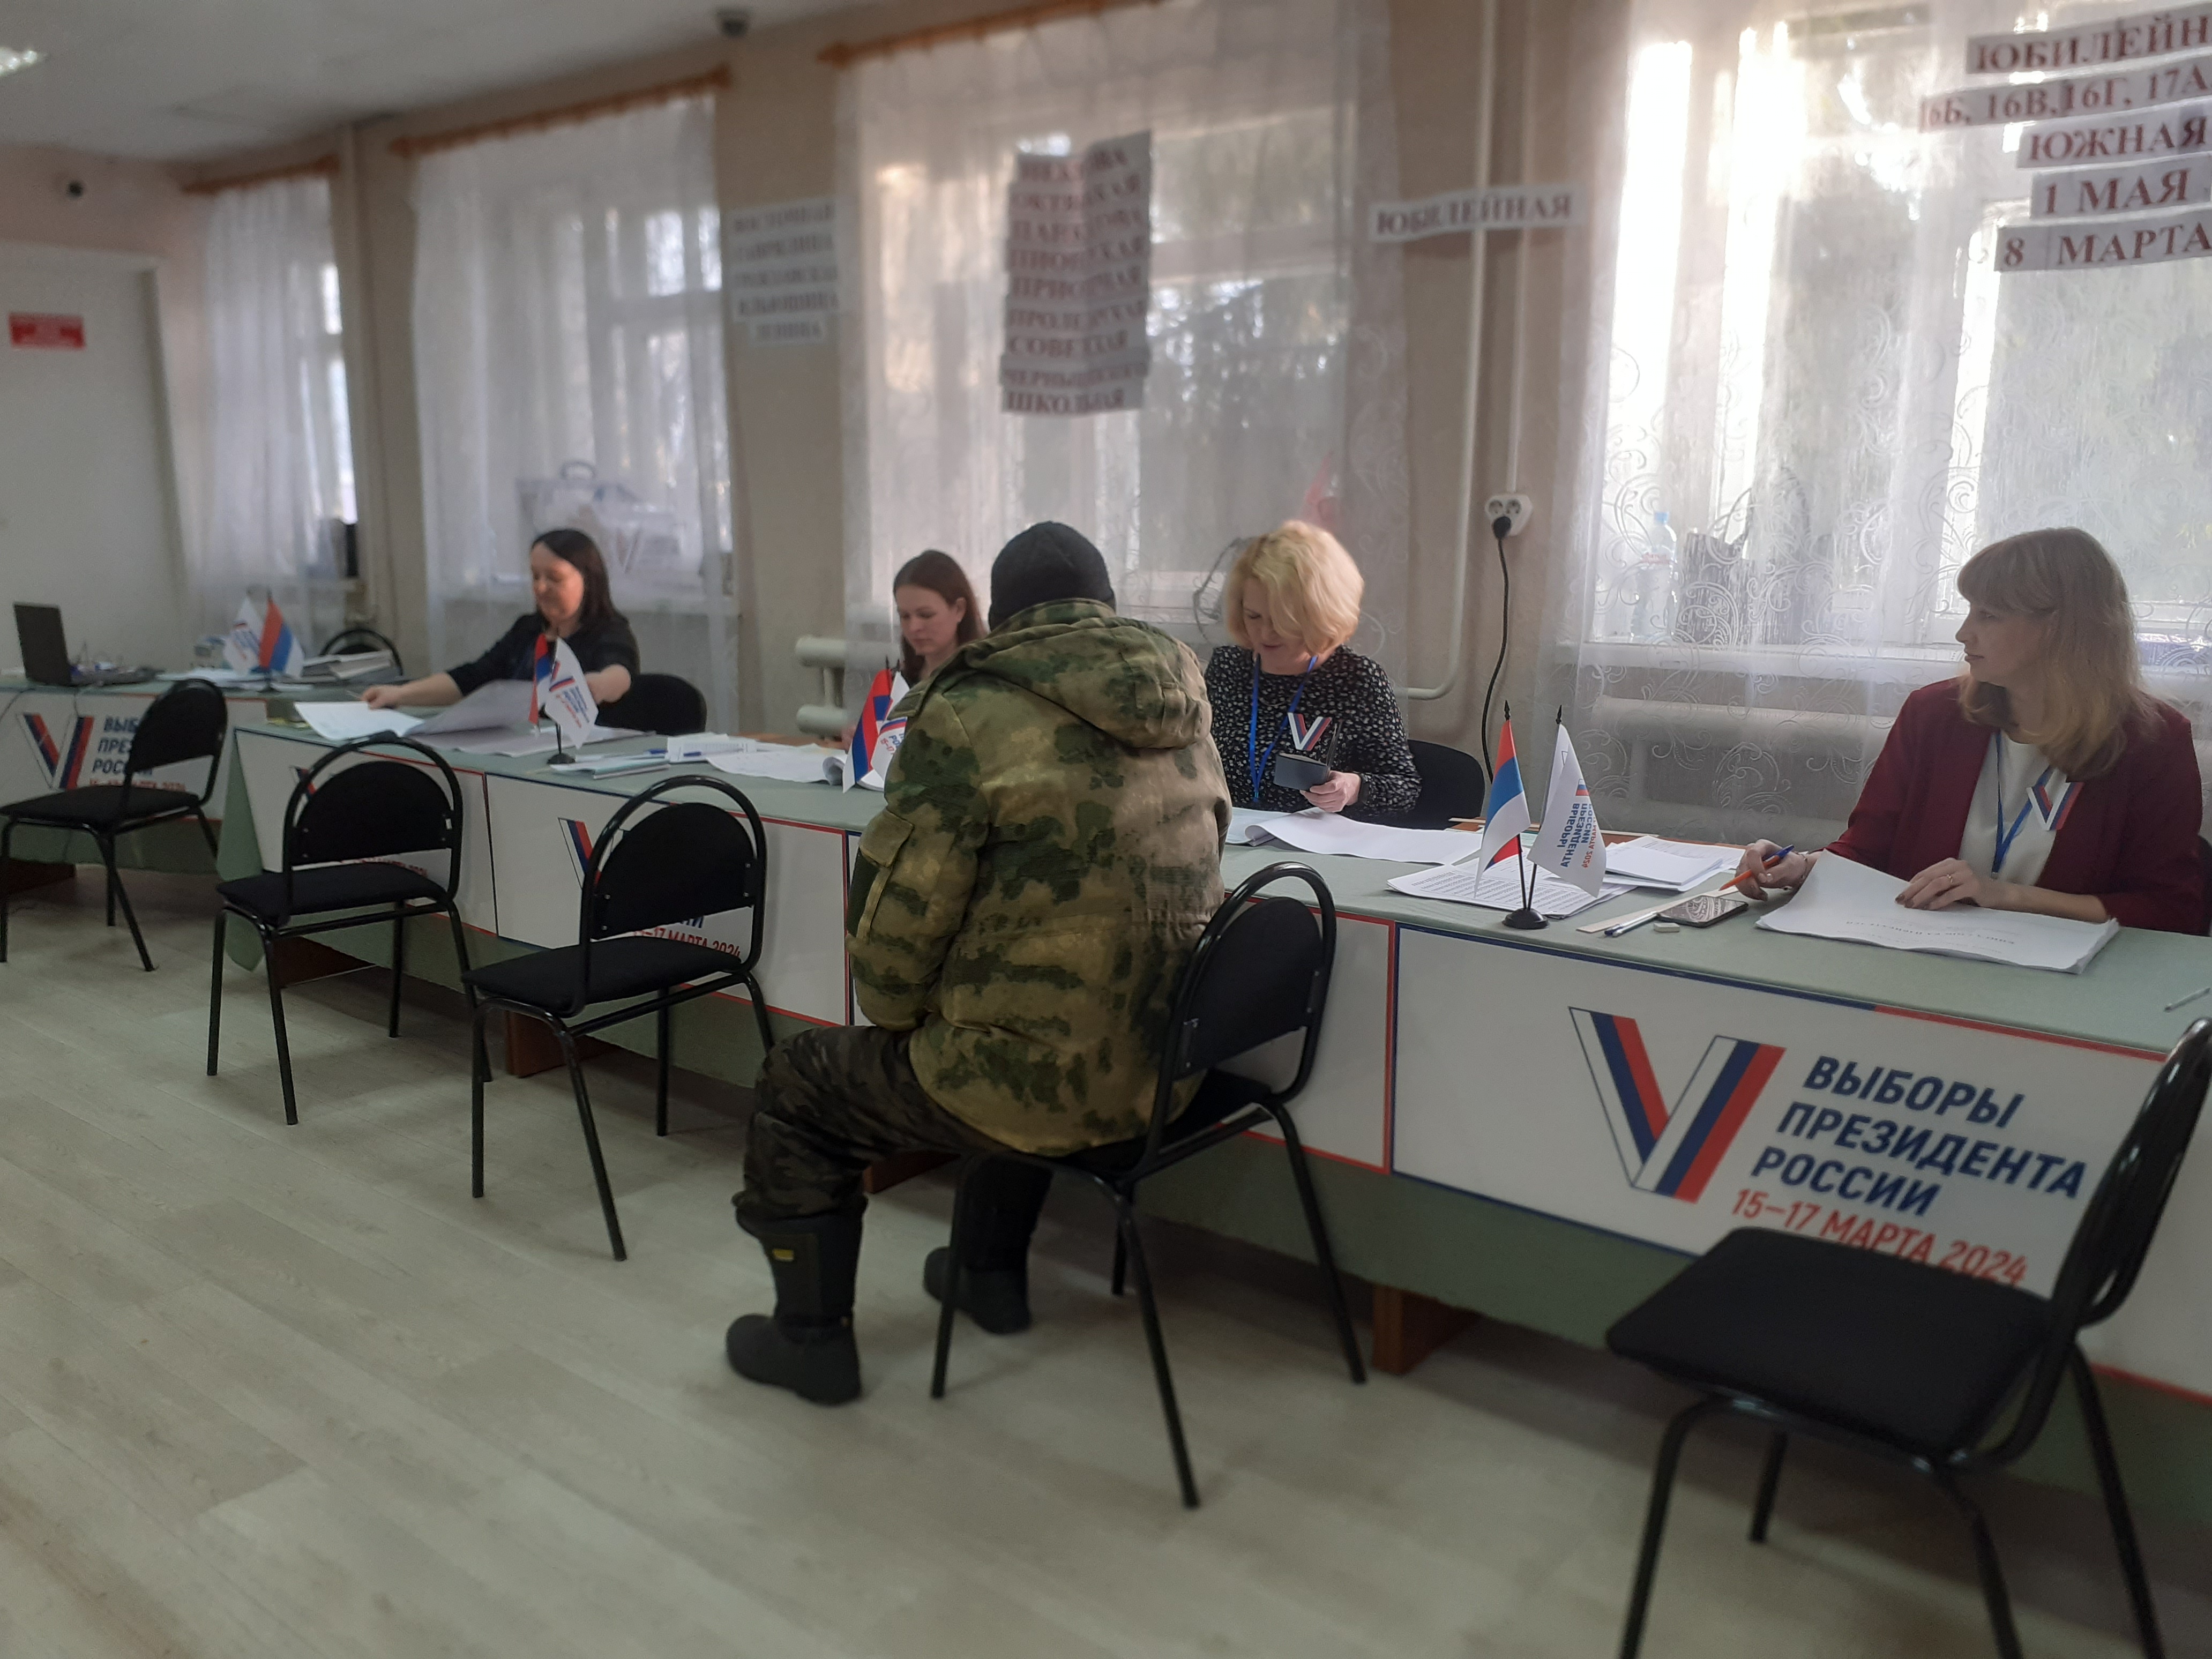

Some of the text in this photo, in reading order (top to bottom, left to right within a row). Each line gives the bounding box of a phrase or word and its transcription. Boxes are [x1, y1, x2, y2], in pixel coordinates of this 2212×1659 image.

[2029, 116, 2207, 161] ЮЖНАЯ
[2045, 169, 2192, 214] 1 МАЯ
[2004, 222, 2211, 266] 8 МАРТА
[1803, 1055, 2026, 1129] ВЫБОРЫ
[1750, 1145, 1942, 1216] РОССИИ
[1776, 1100, 2087, 1199] ПРЕЗИДЕНТА
[1819, 1209, 1937, 1264] МАРТА
[1940, 1239, 2028, 1283] 2024
